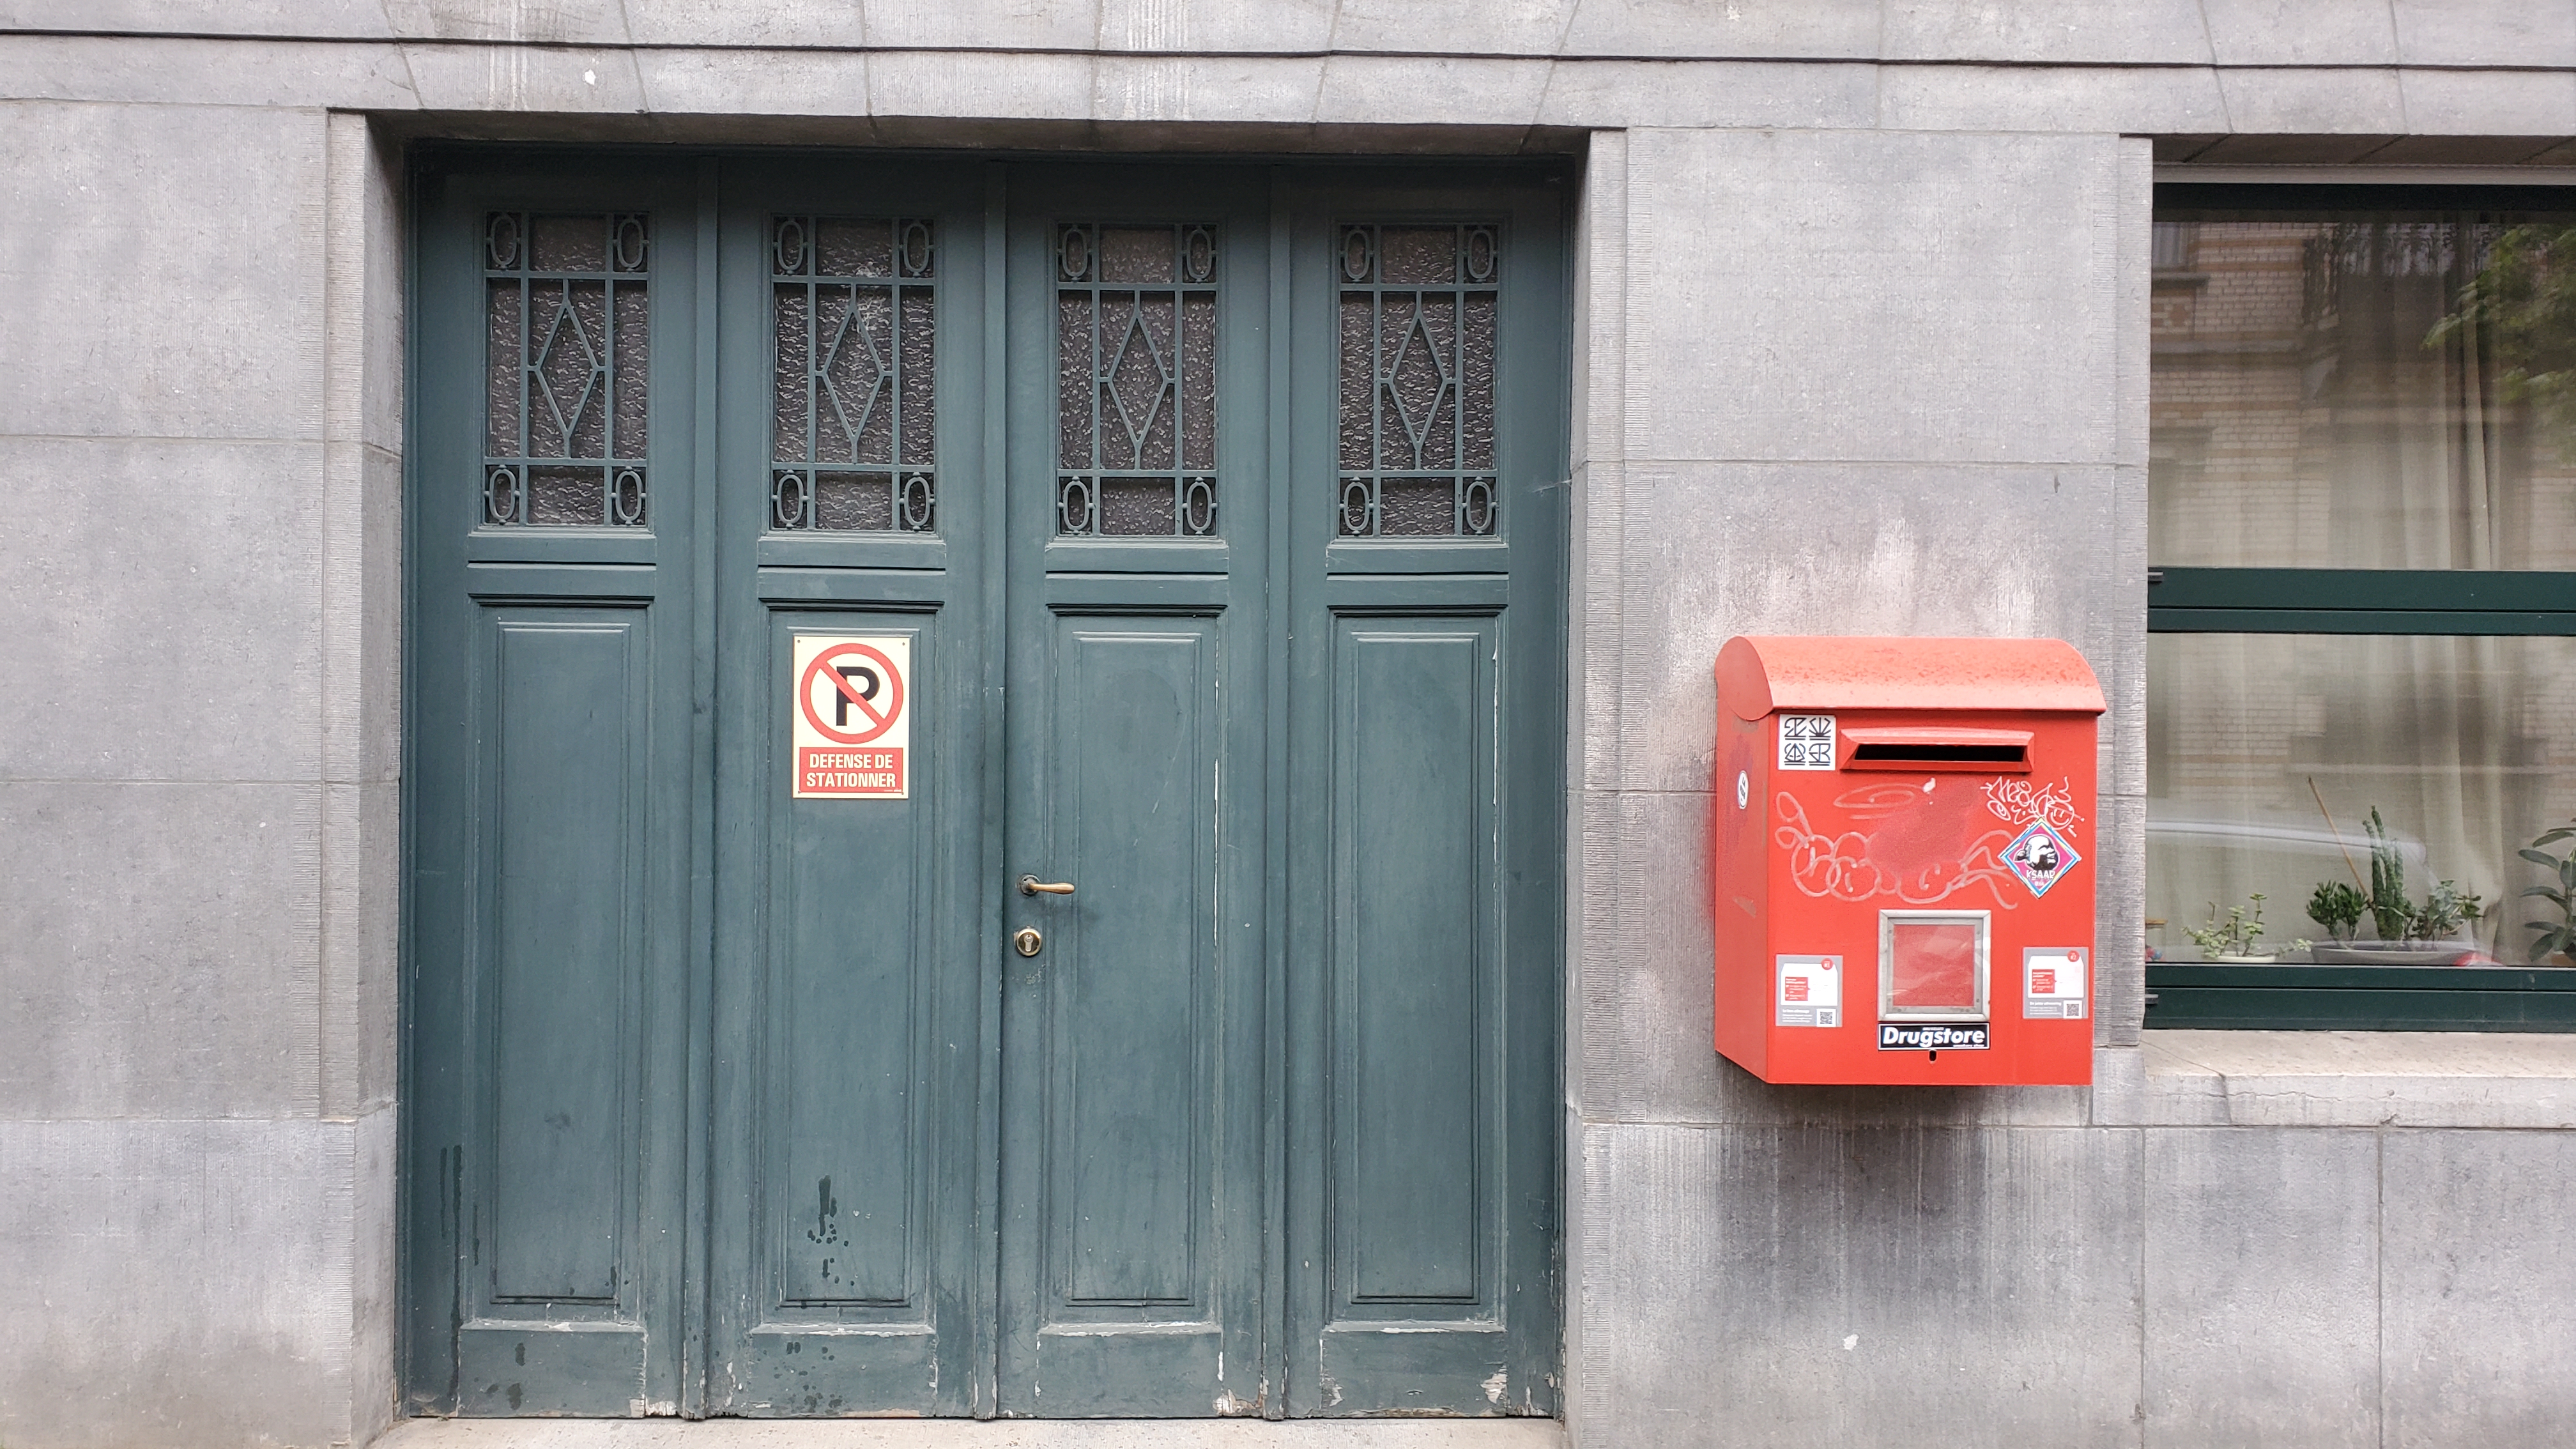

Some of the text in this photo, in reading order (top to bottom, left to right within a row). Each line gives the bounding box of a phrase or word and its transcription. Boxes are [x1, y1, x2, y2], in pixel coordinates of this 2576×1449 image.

[836, 666, 880, 726] P
[809, 753, 893, 769] DEFENSE DE
[806, 772, 896, 788] STATIONNER
[2026, 870, 2057, 880] KSAAR
[1883, 1026, 1986, 1048] Drugstore
